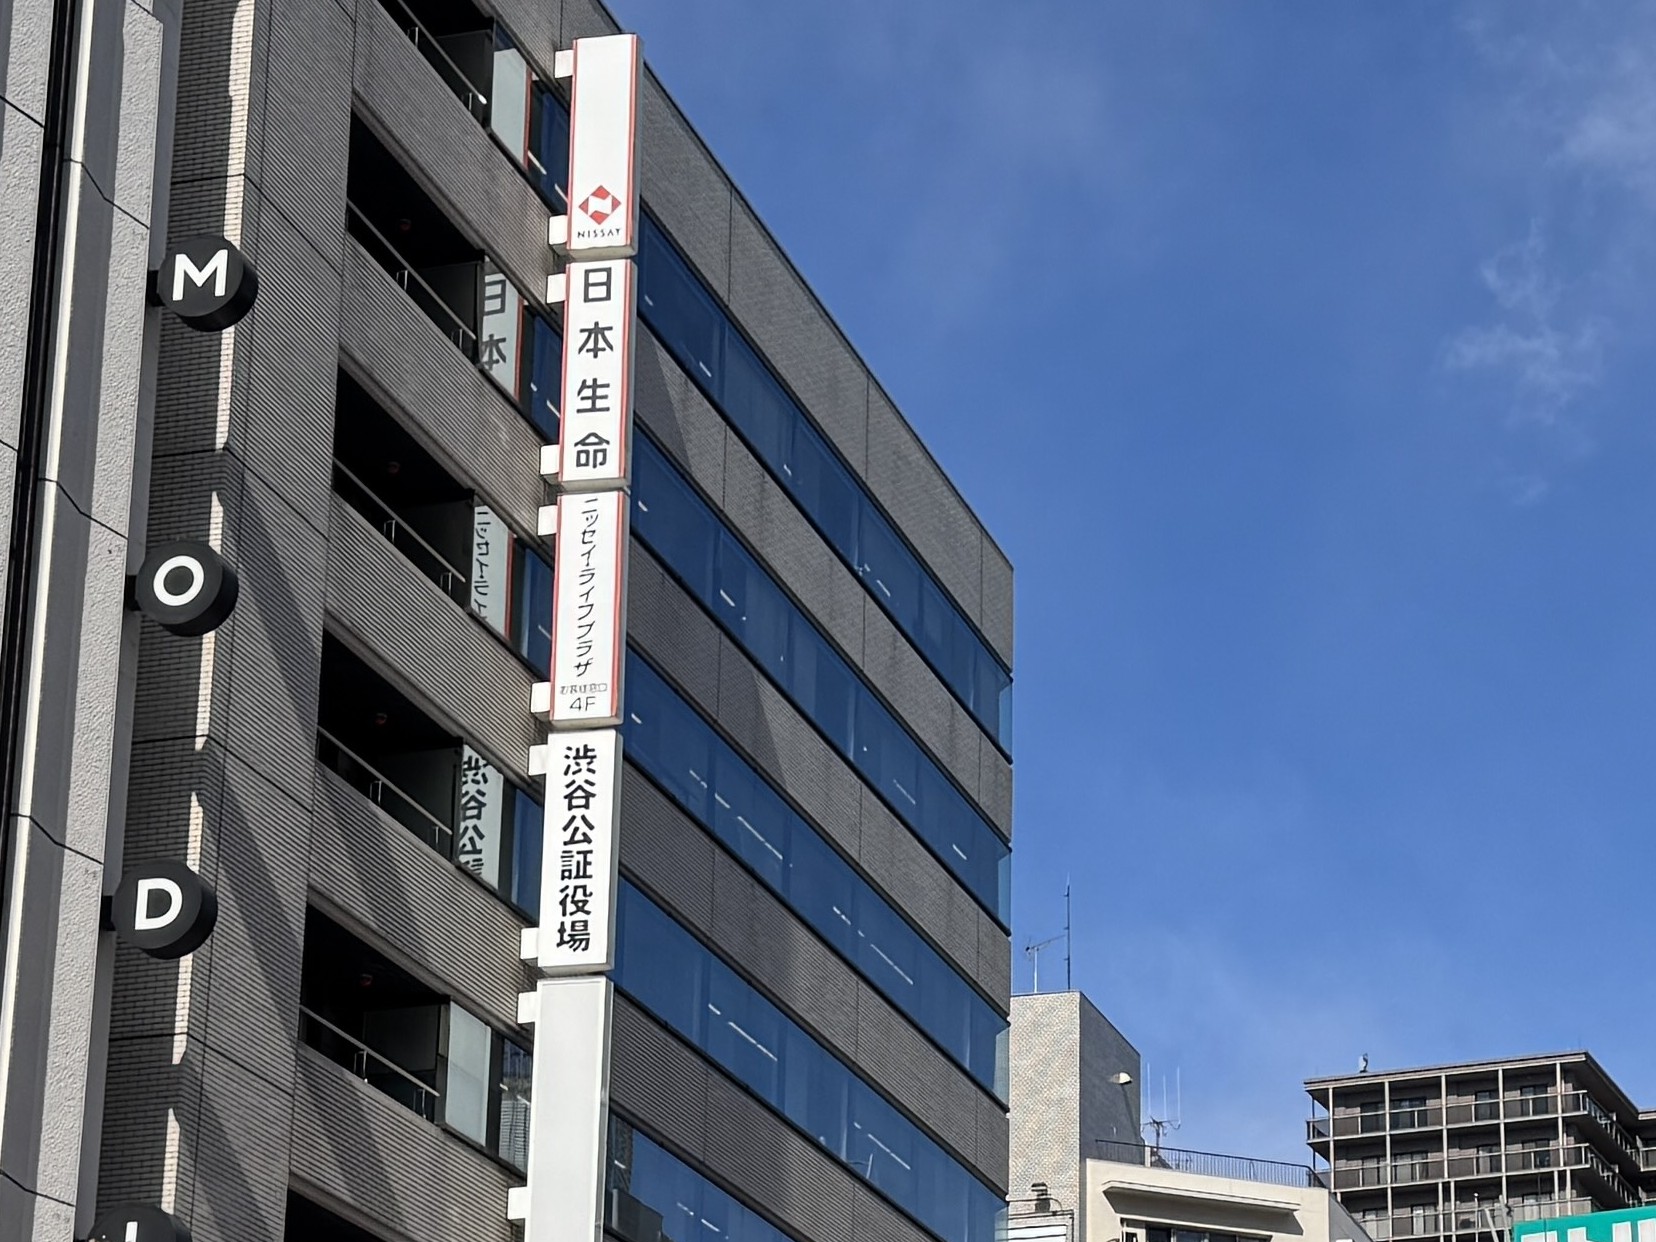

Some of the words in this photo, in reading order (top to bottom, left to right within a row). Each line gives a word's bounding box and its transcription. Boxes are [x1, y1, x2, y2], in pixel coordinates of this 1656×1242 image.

[577, 228, 621, 239] NISSAY
[574, 266, 614, 470] 日本生命
[574, 498, 599, 677] ニッセイライフプラザ
[569, 696, 596, 711] 4F
[556, 744, 598, 953] 渋谷公証役場
